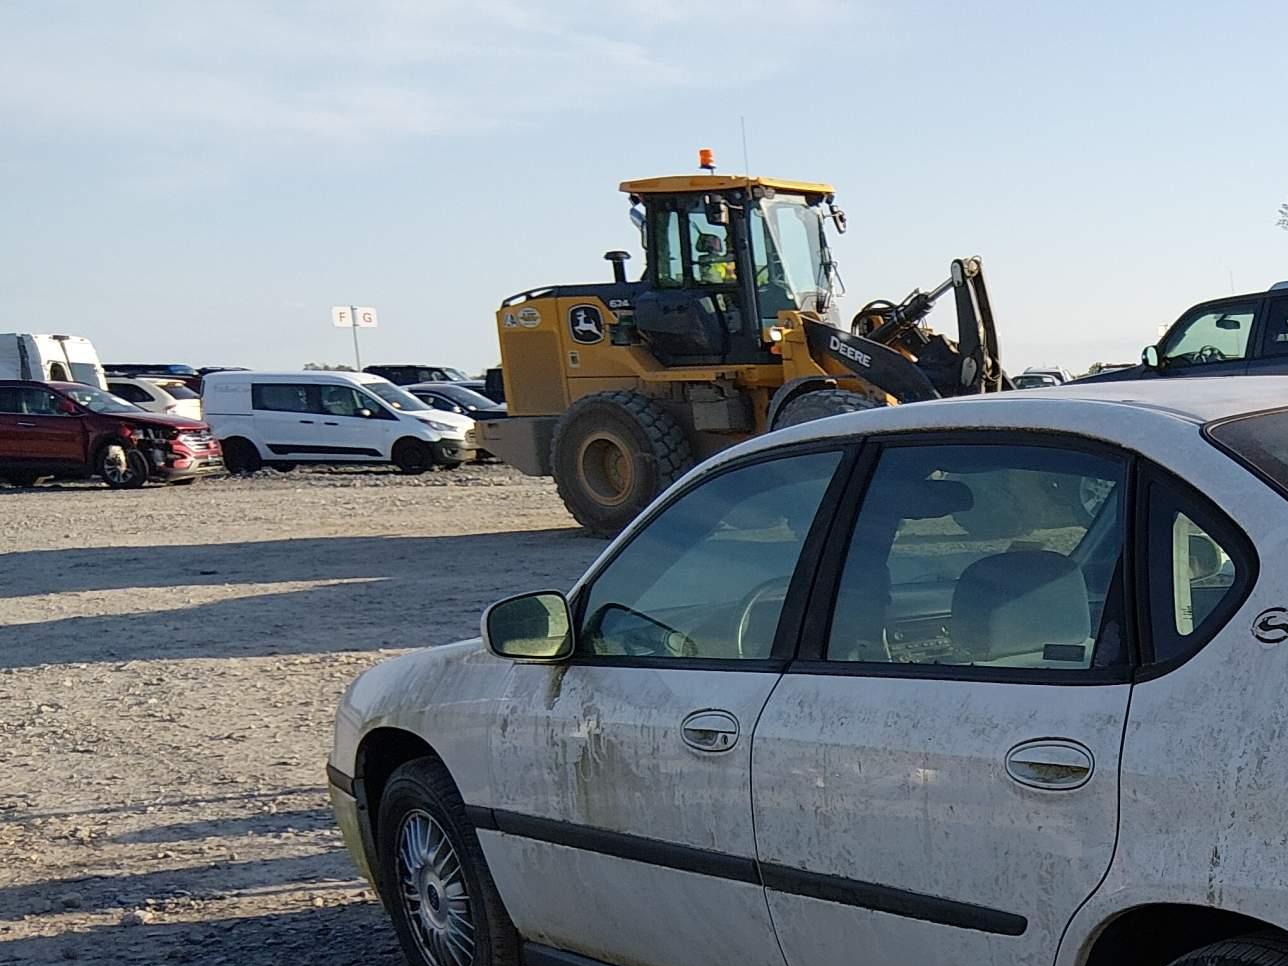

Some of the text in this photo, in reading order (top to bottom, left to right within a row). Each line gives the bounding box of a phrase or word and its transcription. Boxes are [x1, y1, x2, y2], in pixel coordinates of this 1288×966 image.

[339, 311, 346, 322] F
[362, 312, 373, 323] G
[829, 335, 872, 368] DEERE
